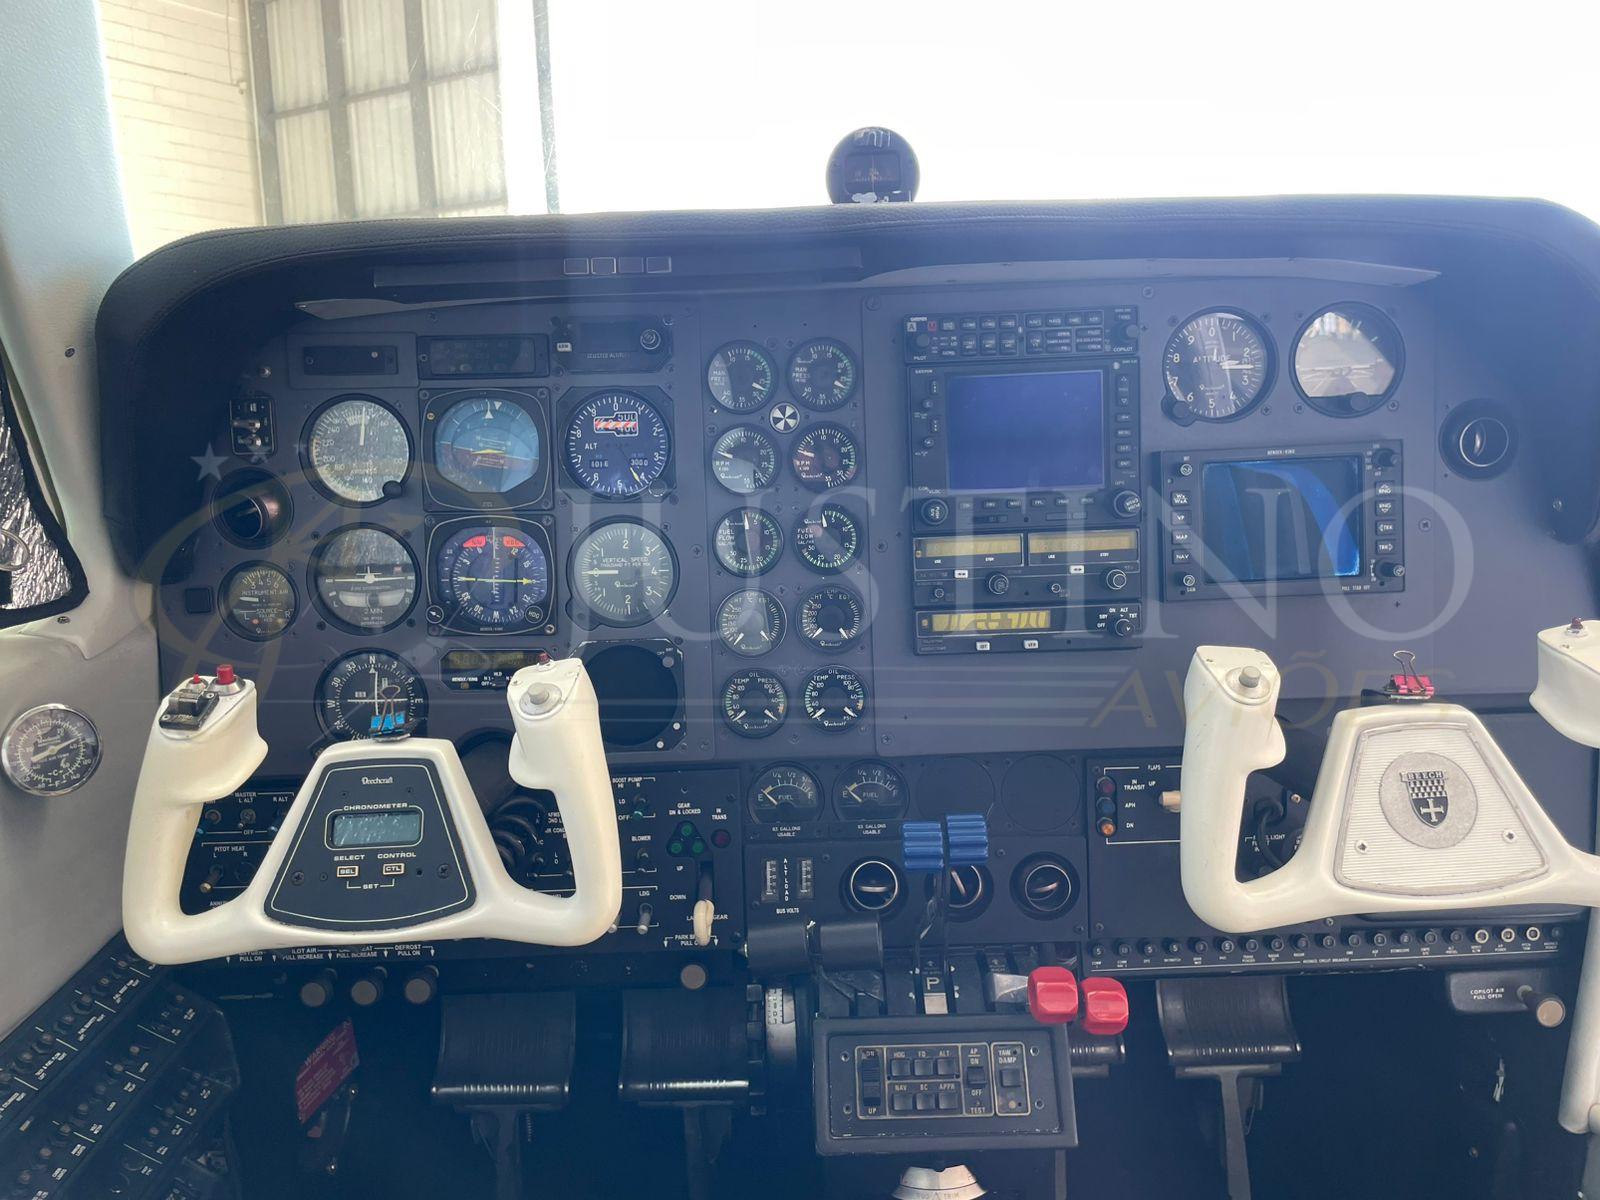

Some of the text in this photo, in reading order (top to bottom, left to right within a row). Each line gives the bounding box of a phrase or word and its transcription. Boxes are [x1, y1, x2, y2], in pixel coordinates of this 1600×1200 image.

[1209, 328, 1215, 337] 0
[1188, 336, 1194, 345] 9
[1244, 348, 1250, 357] 2
[1173, 353, 1180, 363] 8
[1172, 377, 1178, 386] 7
[1242, 376, 1248, 385] 3
[1187, 392, 1194, 402] 6
[1230, 391, 1236, 400] 4
[1209, 398, 1215, 408] 5
[576, 429, 582, 438] 8
[652, 427, 658, 436] 2
[584, 442, 598, 450] ALT
[576, 455, 582, 464] 7
[654, 452, 660, 461] 3
[622, 539, 628, 549] 2
[645, 547, 651, 556] 3
[651, 567, 658, 575] 4
[646, 586, 653, 595] 3
[625, 595, 631, 604] 2
[528, 611, 540, 620] HDG
[370, 656, 375, 664] N
[346, 661, 356, 671] 33
[331, 677, 341, 688] 30
[327, 700, 336, 708] W
[1408, 771, 1442, 780] BEECH
[362, 776, 393, 785] Beechcraft
[343, 803, 408, 811] CHRONOMETER
[926, 977, 940, 990] P
